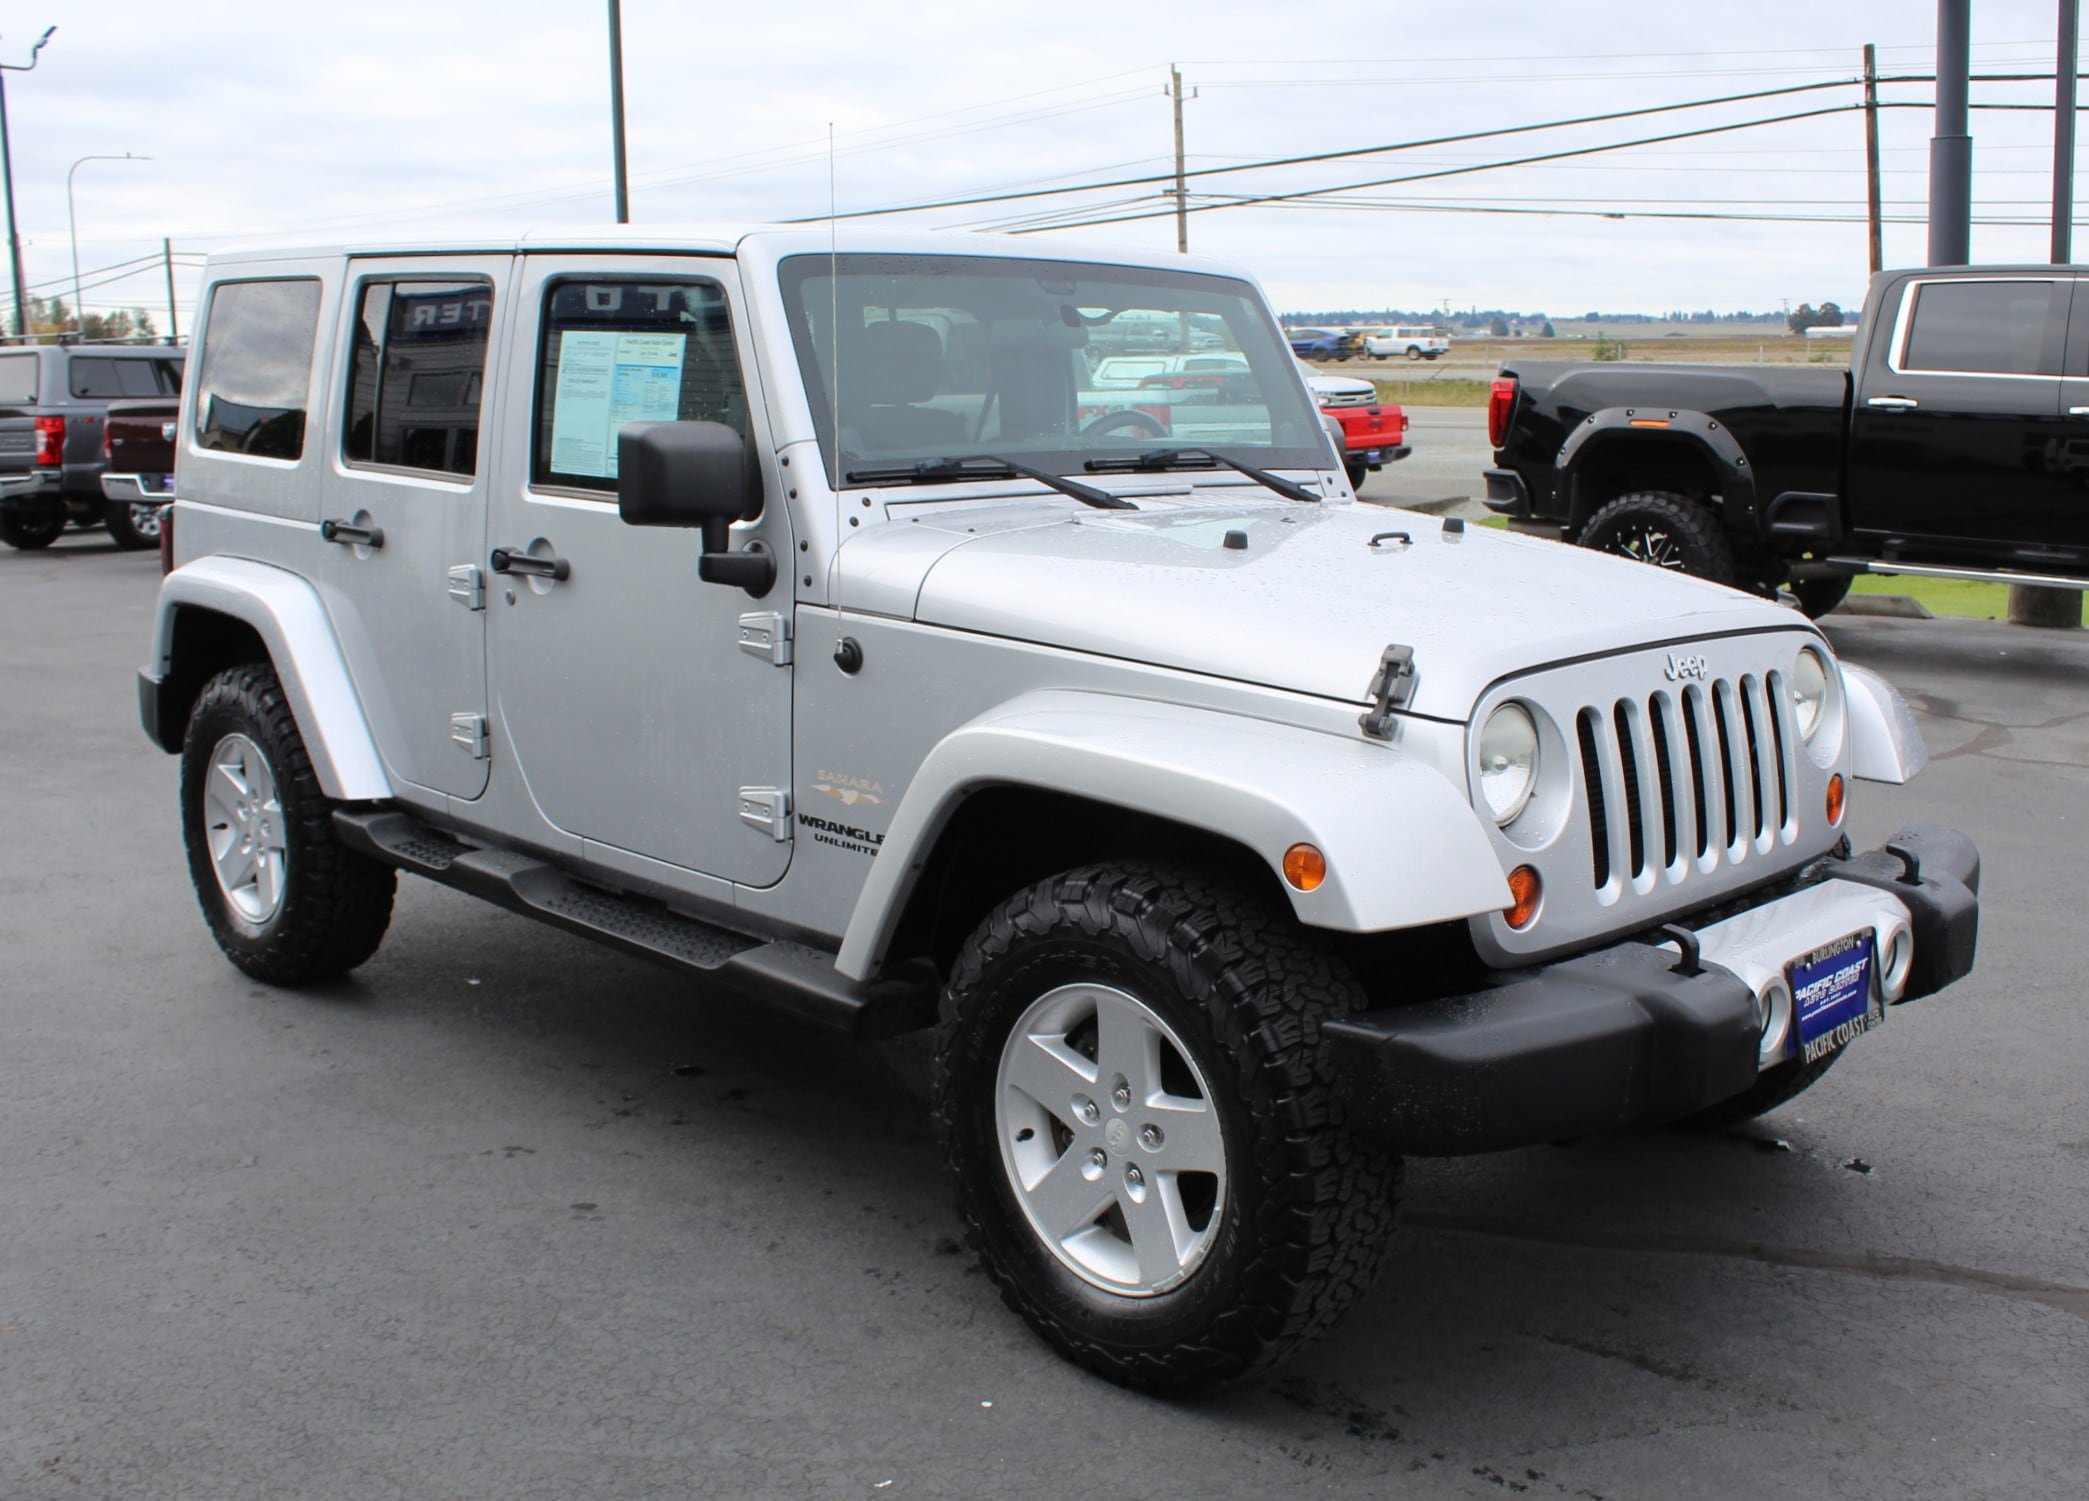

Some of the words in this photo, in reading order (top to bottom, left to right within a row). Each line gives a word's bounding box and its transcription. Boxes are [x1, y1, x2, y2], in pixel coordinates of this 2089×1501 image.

[1664, 653, 1708, 681] Jeep
[1794, 973, 1834, 1001] PACIFIC
[1834, 956, 1868, 983] COAST
[1804, 1032, 1836, 1064] PACIFIC
[1837, 1015, 1866, 1045] COAST
